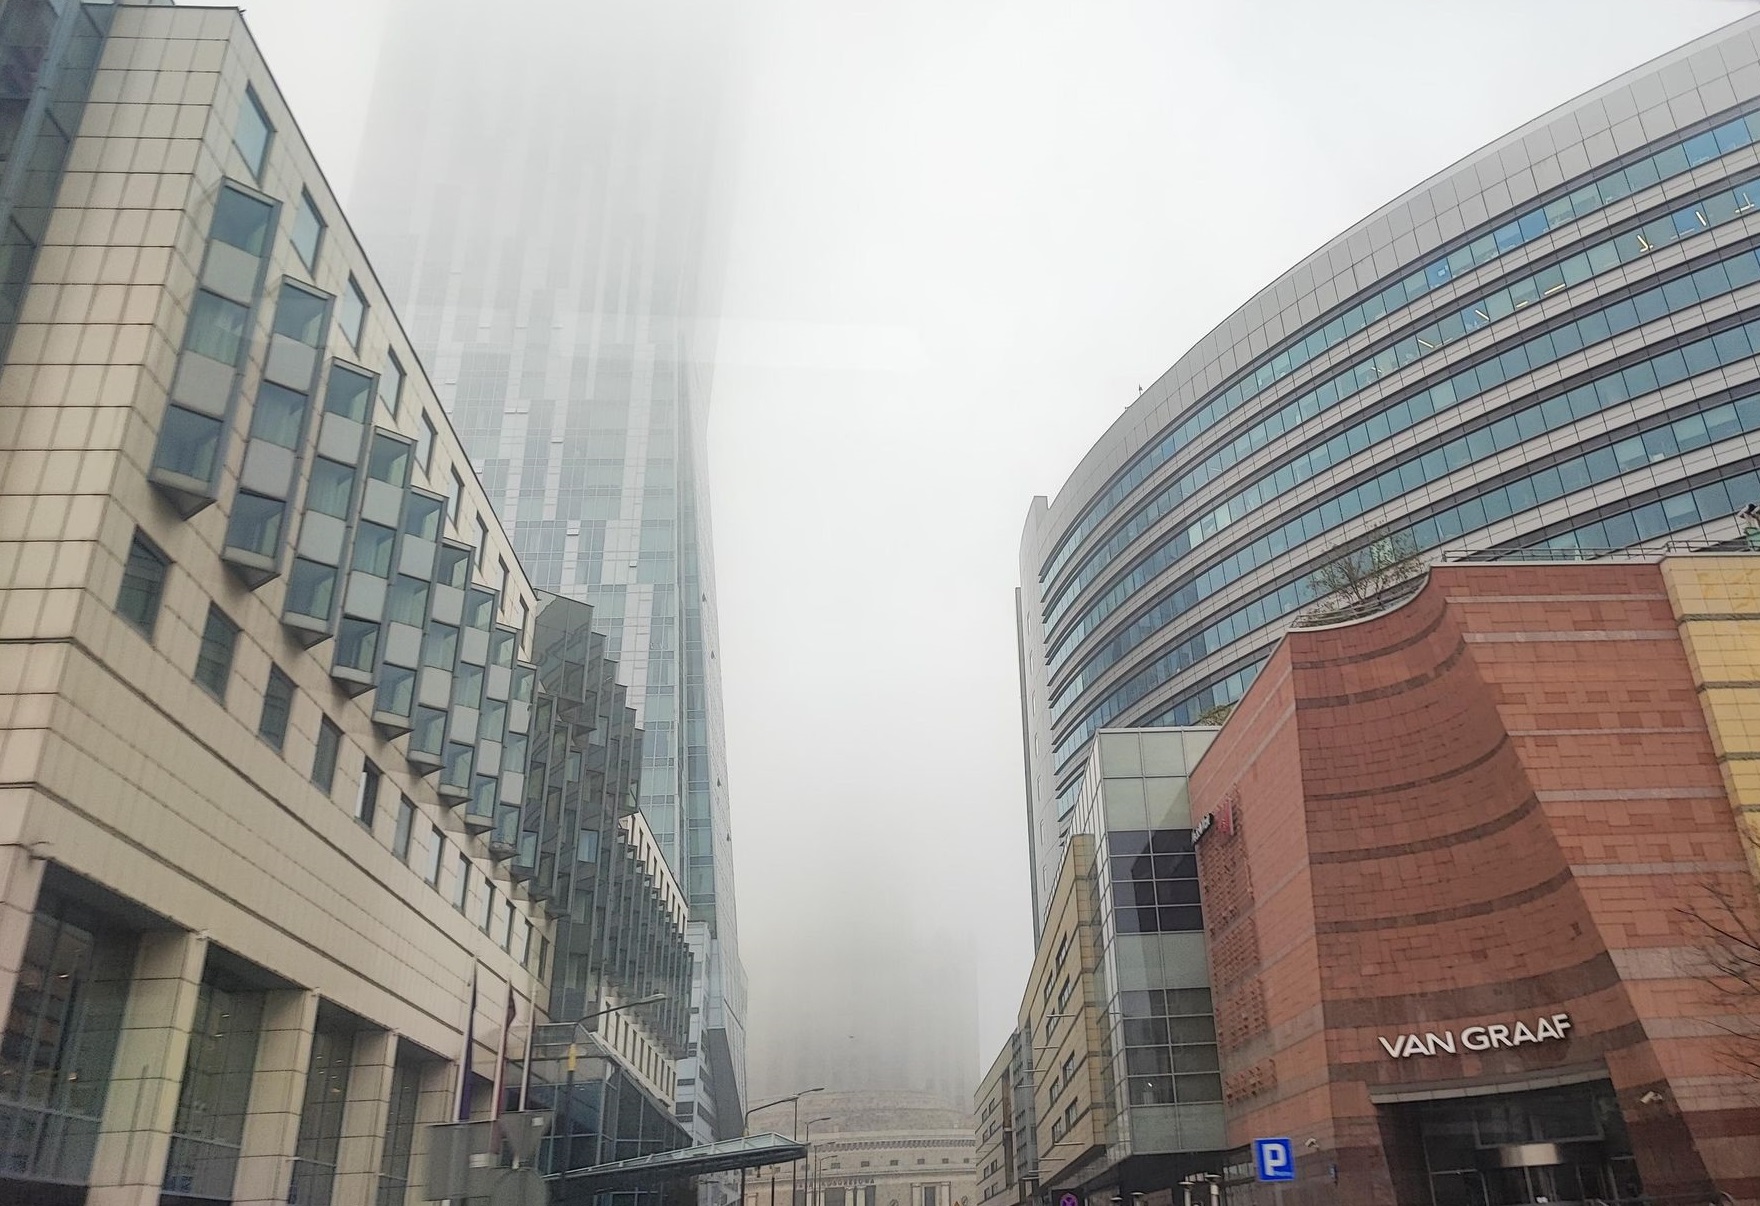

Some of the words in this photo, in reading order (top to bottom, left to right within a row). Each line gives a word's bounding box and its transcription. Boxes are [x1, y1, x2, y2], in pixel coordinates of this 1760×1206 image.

[1378, 1031, 1457, 1058] VAN
[1460, 1013, 1571, 1051] GRAAF
[1261, 1143, 1287, 1176] P
